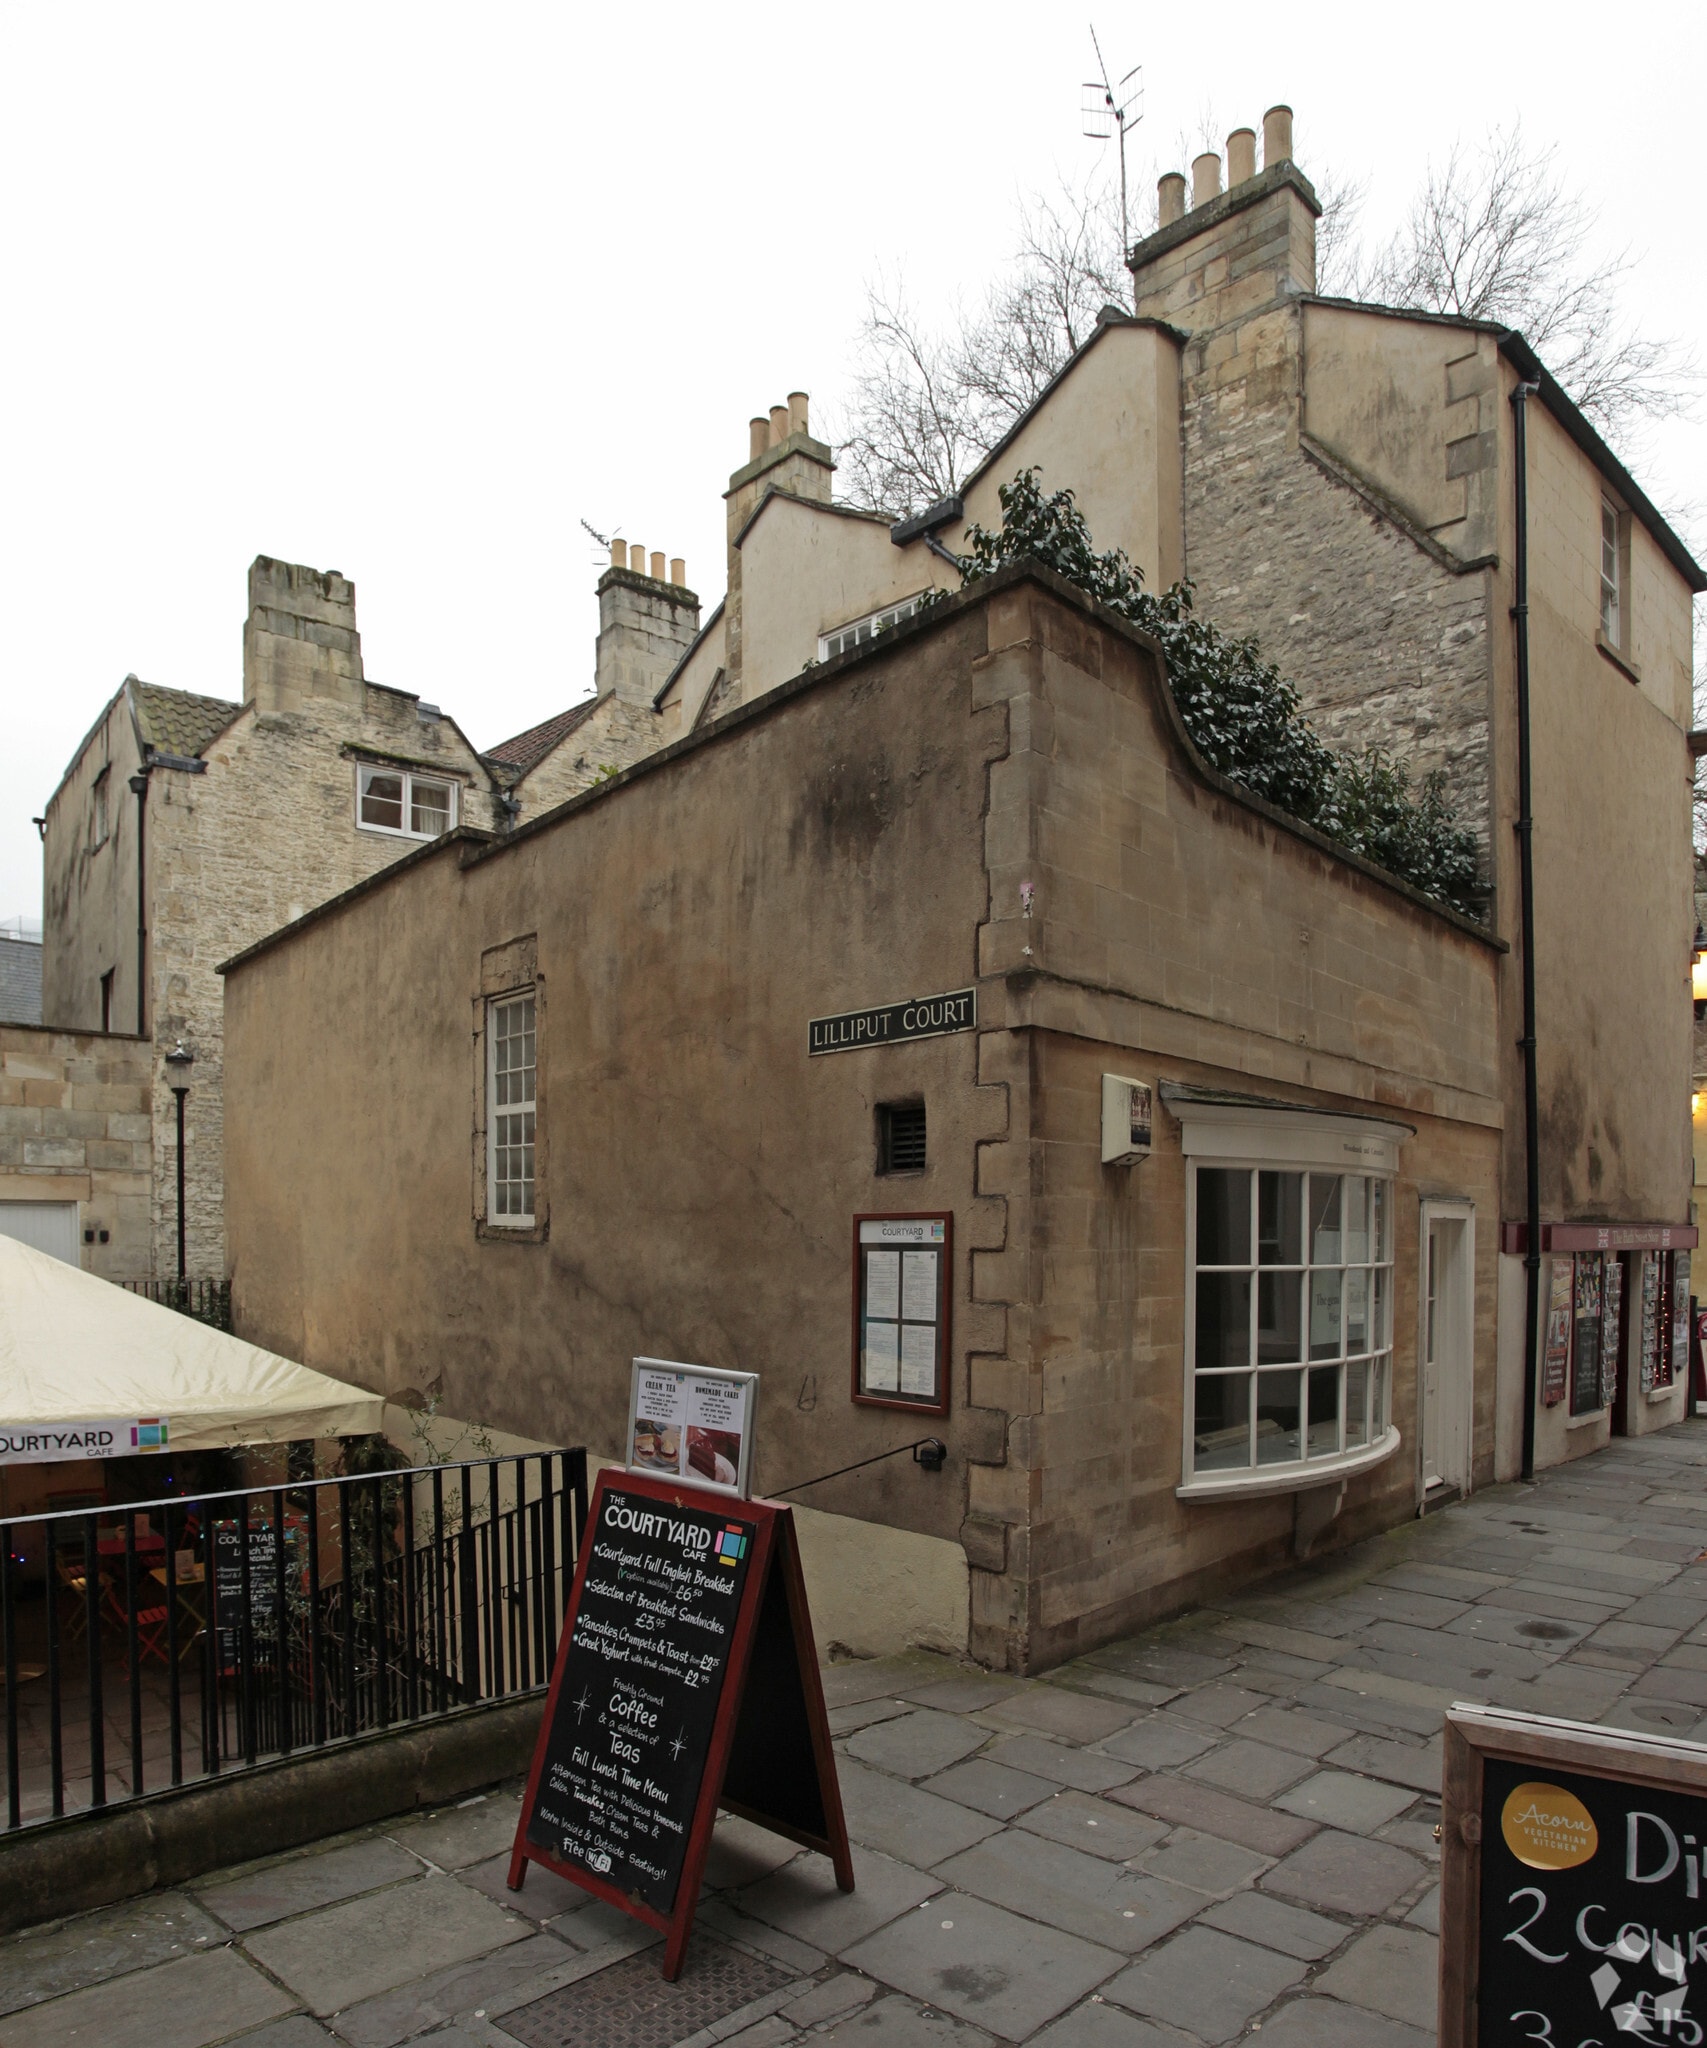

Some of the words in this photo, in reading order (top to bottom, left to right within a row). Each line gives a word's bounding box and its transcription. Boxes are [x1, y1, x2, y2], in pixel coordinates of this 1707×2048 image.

[814, 1012, 892, 1047] LILLIPUT
[903, 997, 969, 1031] COURT
[882, 1227, 924, 1236] COURTYARD
[645, 1381, 663, 1392] CREAM
[666, 1383, 676, 1393] TEA
[695, 1386, 721, 1397] HOMEMADE
[724, 1390, 739, 1400] CAKES
[86, 1447, 114, 1457] CAFE
[609, 1494, 626, 1506] THE
[604, 1505, 711, 1550] COURTYARD
[598, 1542, 643, 1566] Courtyard
[644, 1555, 661, 1574] Full
[661, 1560, 692, 1584] English
[693, 1569, 735, 1596] Breakfast
[682, 1548, 707, 1563] CAFE
[590, 1579, 624, 1602] Selection
[625, 1590, 637, 1605] of
[636, 1592, 678, 1618] Breakfast
[678, 1607, 725, 1635] Sandwiches
[578, 1632, 600, 1652] Greek
[600, 1638, 630, 1662] Yoghurt
[630, 1654, 643, 1664] with
[643, 1656, 658, 1669] fruit
[619, 1627, 657, 1652] Crumpets
[656, 1639, 666, 1655] &
[666, 1641, 690, 1664] Toast
[612, 1677, 637, 1699] Freshly
[637, 1688, 664, 1708] Ground
[609, 1693, 658, 1728] Coffee
[598, 1712, 607, 1725] &
[608, 1720, 615, 1728] a
[617, 1723, 649, 1742] selection
[649, 1735, 660, 1746] of
[609, 1730, 641, 1764] Teas
[571, 1746, 590, 1767] Full
[591, 1755, 618, 1781] Lunch
[621, 1767, 642, 1790] Time
[643, 1778, 669, 1804] Menu
[550, 1762, 586, 1787] Afternoon
[590, 1779, 602, 1794] Tea
[603, 1788, 619, 1802] with
[620, 1794, 651, 1817] Delicious
[653, 1809, 684, 1834] Homemade
[588, 1810, 606, 1829] Bath
[609, 1821, 629, 1839] Buns
[605, 1804, 629, 1823] Cream
[632, 1815, 649, 1833] Teas
[651, 1825, 661, 1839] &
[1513, 1803, 1592, 1832] Acorn
[539, 1806, 560, 1826] Warm
[561, 1816, 583, 1837] Inside
[583, 1829, 592, 1842] &
[593, 1834, 625, 1859] Outside
[628, 1853, 668, 1881] Seating!!
[562, 1837, 585, 1858] Free
[1523, 1827, 1587, 1845] VEGETARIAN
[1533, 1838, 1577, 1853] KITCHEN
[1625, 1811, 1707, 1899] Di
[1502, 1886, 1570, 1964] 2
